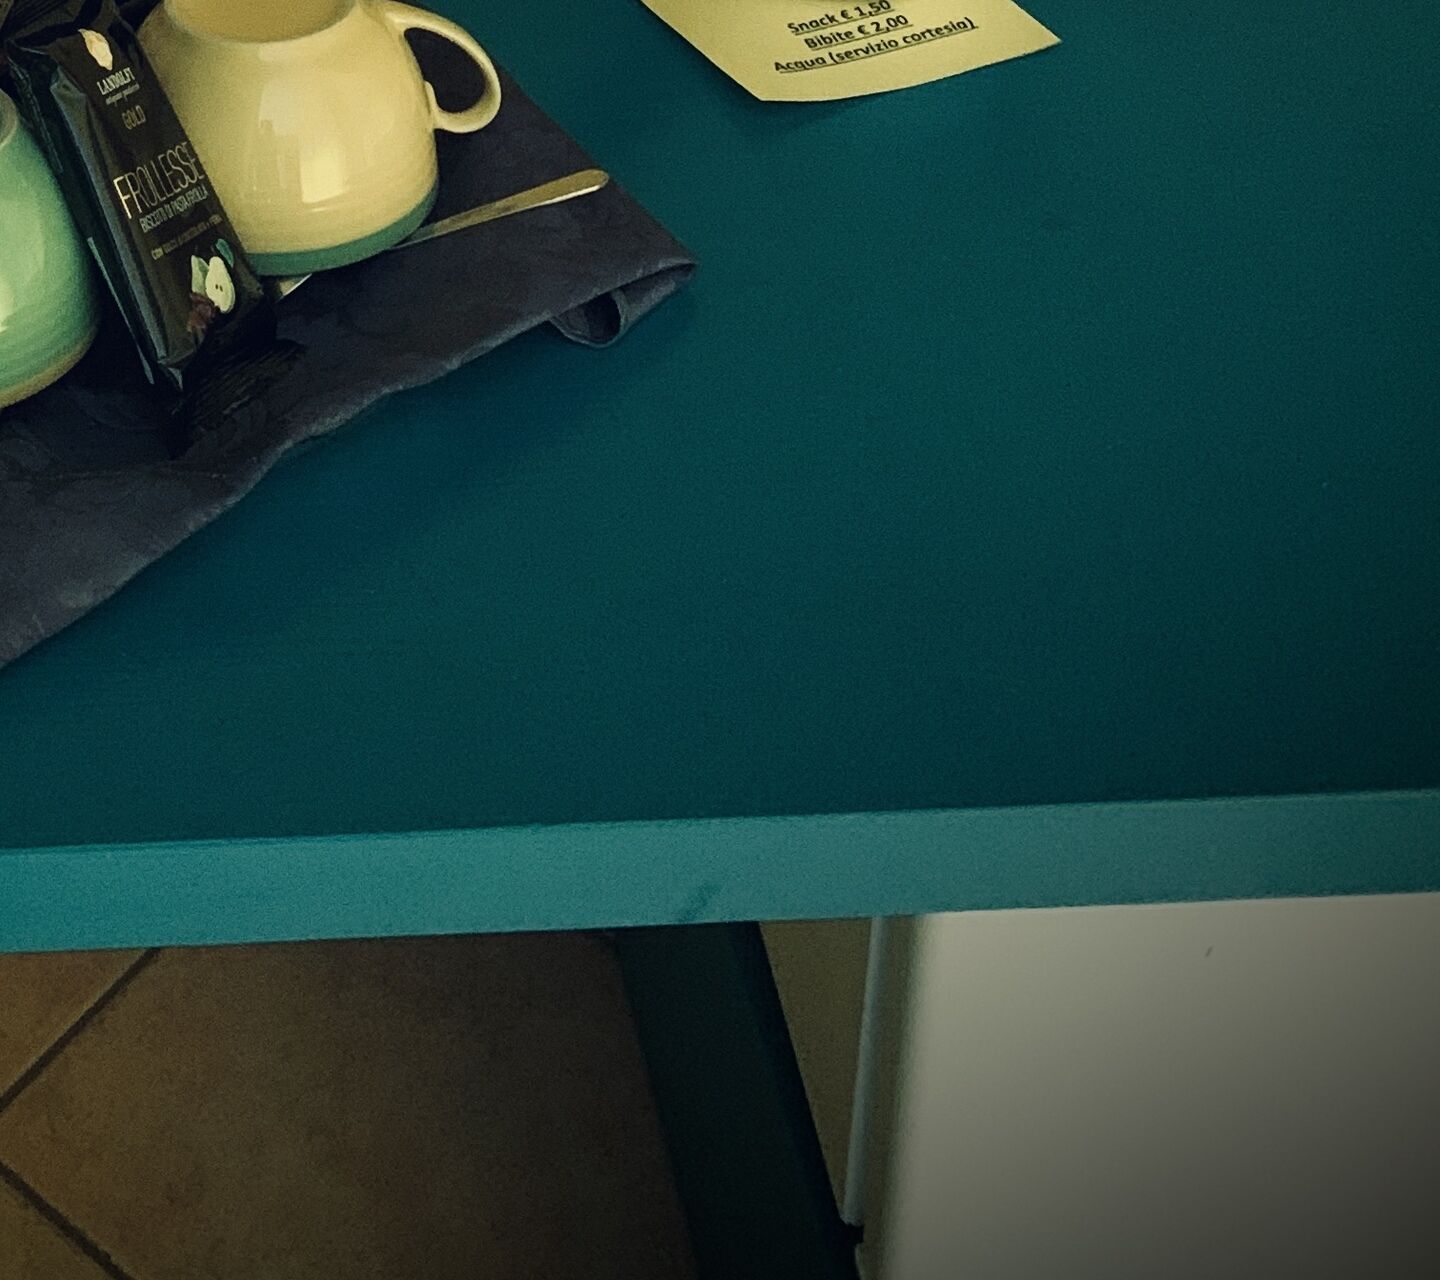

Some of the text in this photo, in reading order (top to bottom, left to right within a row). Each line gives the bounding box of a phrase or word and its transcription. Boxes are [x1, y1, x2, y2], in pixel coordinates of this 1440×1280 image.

[787, 14, 838, 34] Snack
[840, 9, 853, 20] €
[804, 14, 909, 49] Bibite € 2,00
[773, 16, 976, 72] Acqua (servizio cortesia)
[121, 104, 147, 131] GOLD
[112, 142, 205, 220] FROLLESSE
